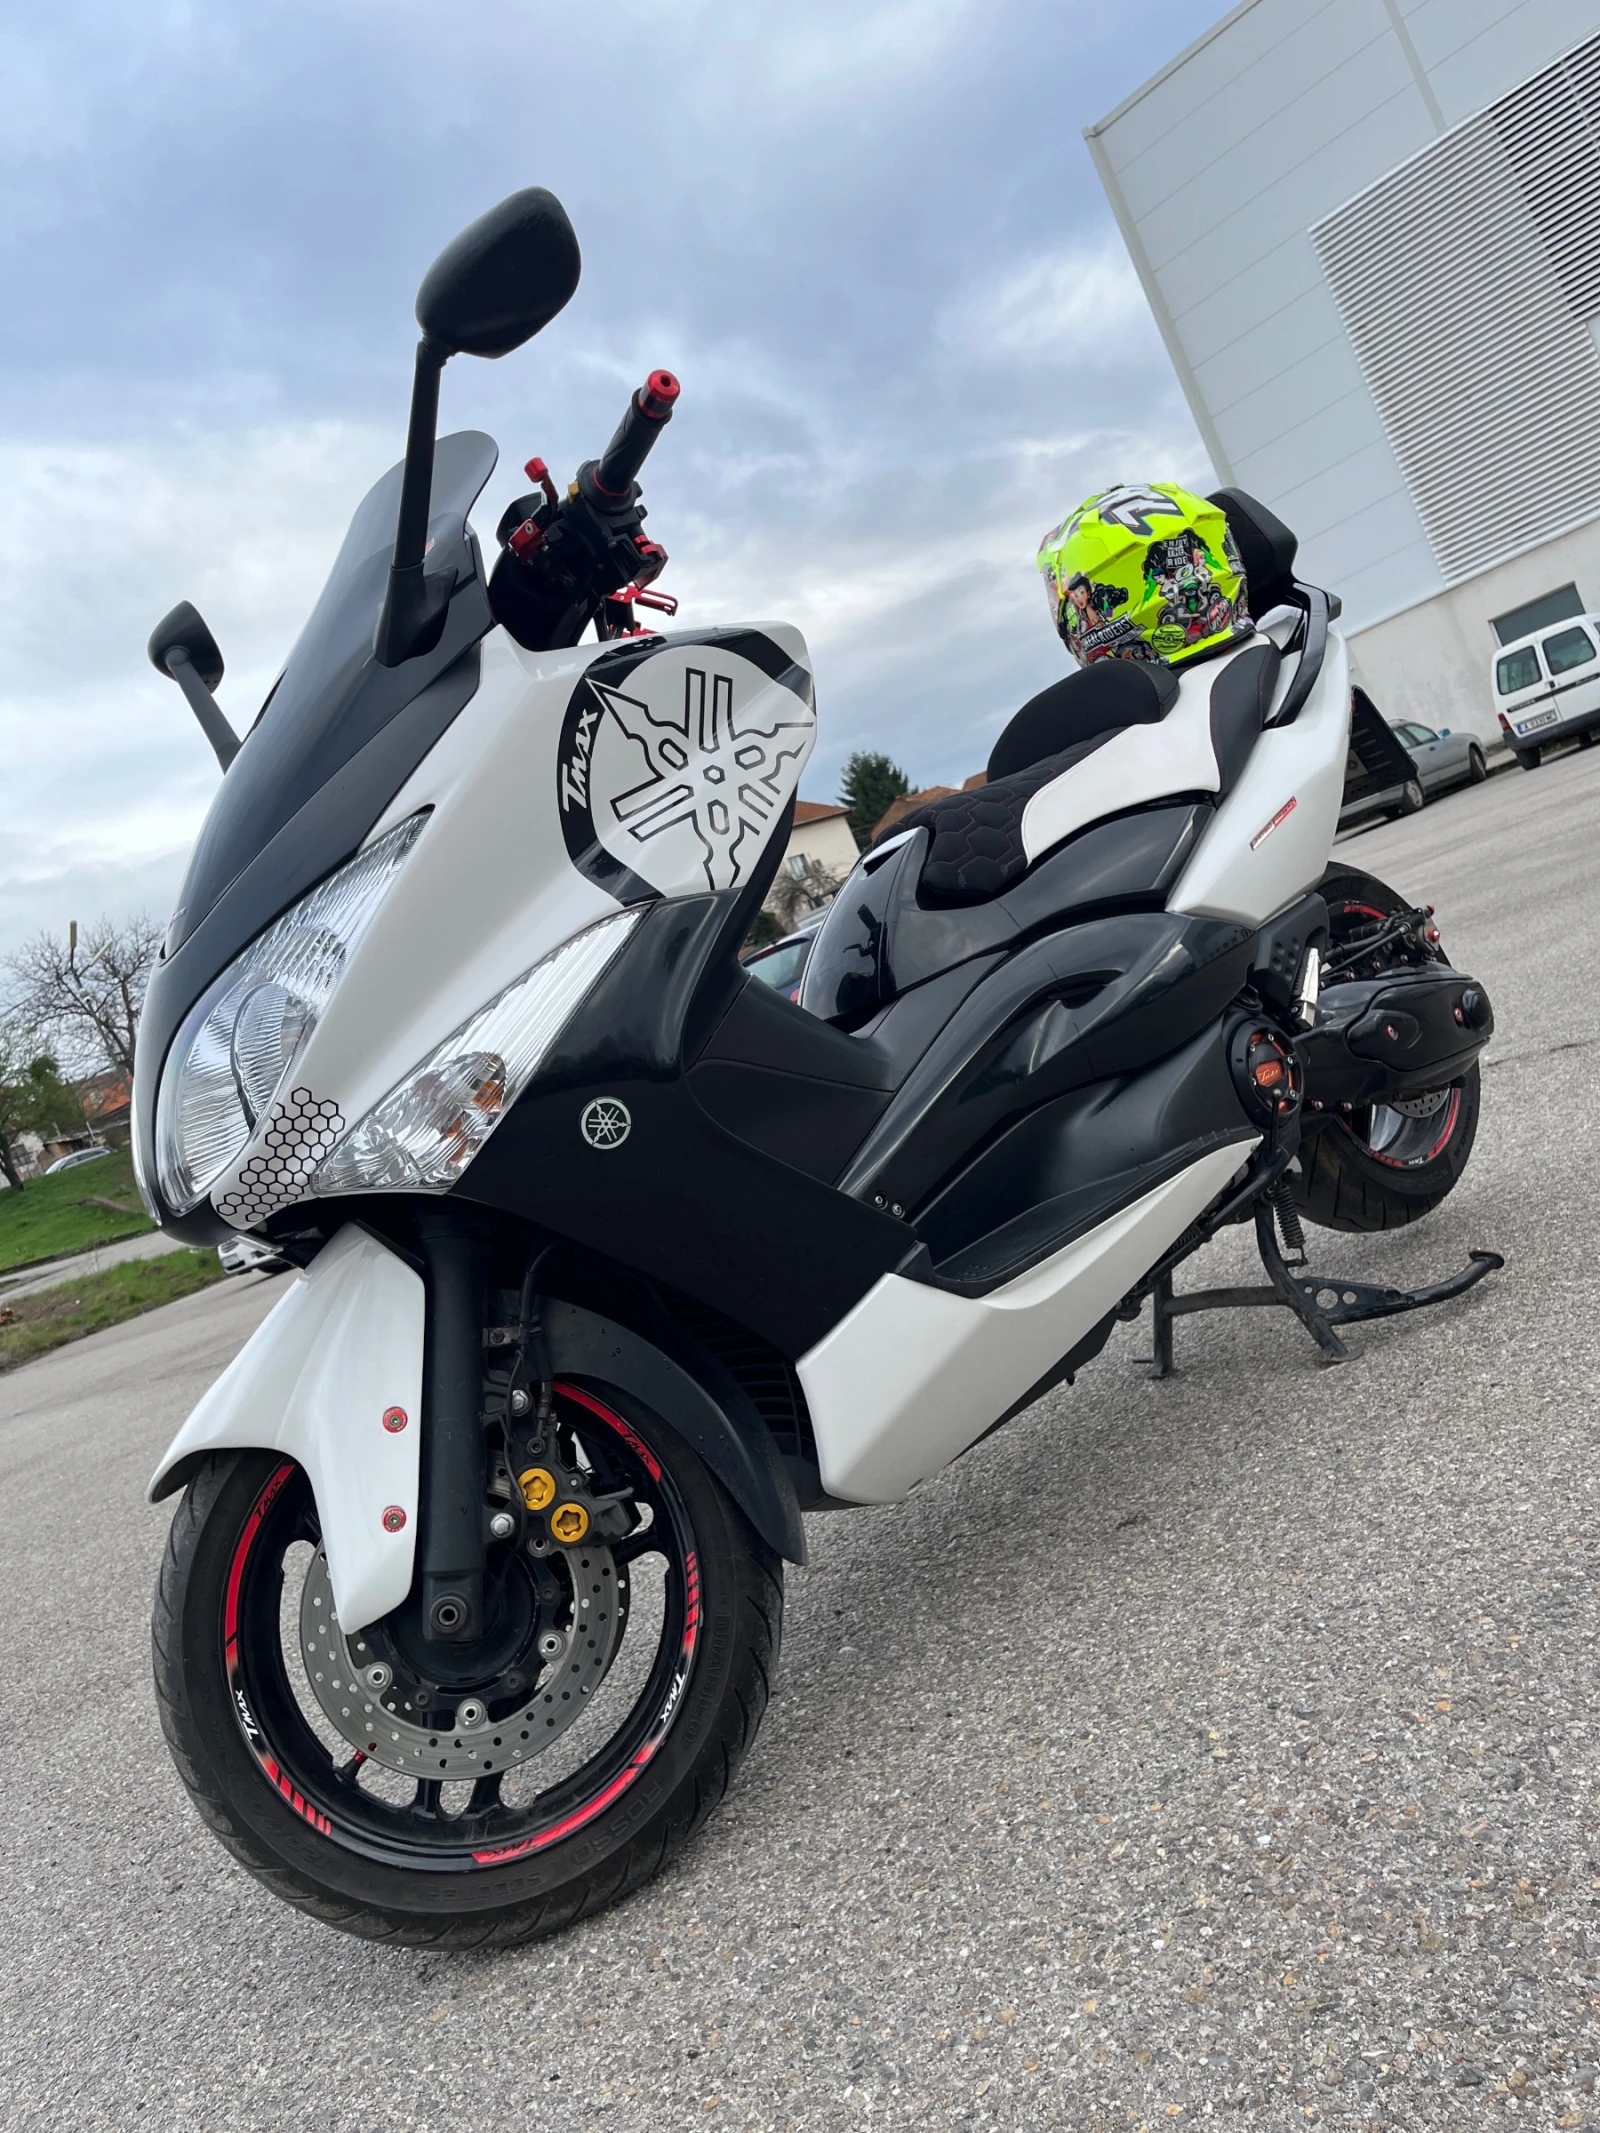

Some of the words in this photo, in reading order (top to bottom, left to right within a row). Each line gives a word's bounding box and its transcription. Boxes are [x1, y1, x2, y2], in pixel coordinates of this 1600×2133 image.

[1163, 539, 1187, 548] ENJOY
[1167, 556, 1188, 566] RIDE
[1098, 620, 1130, 642] RIDERS
[571, 1780, 665, 1865] ROSSO
